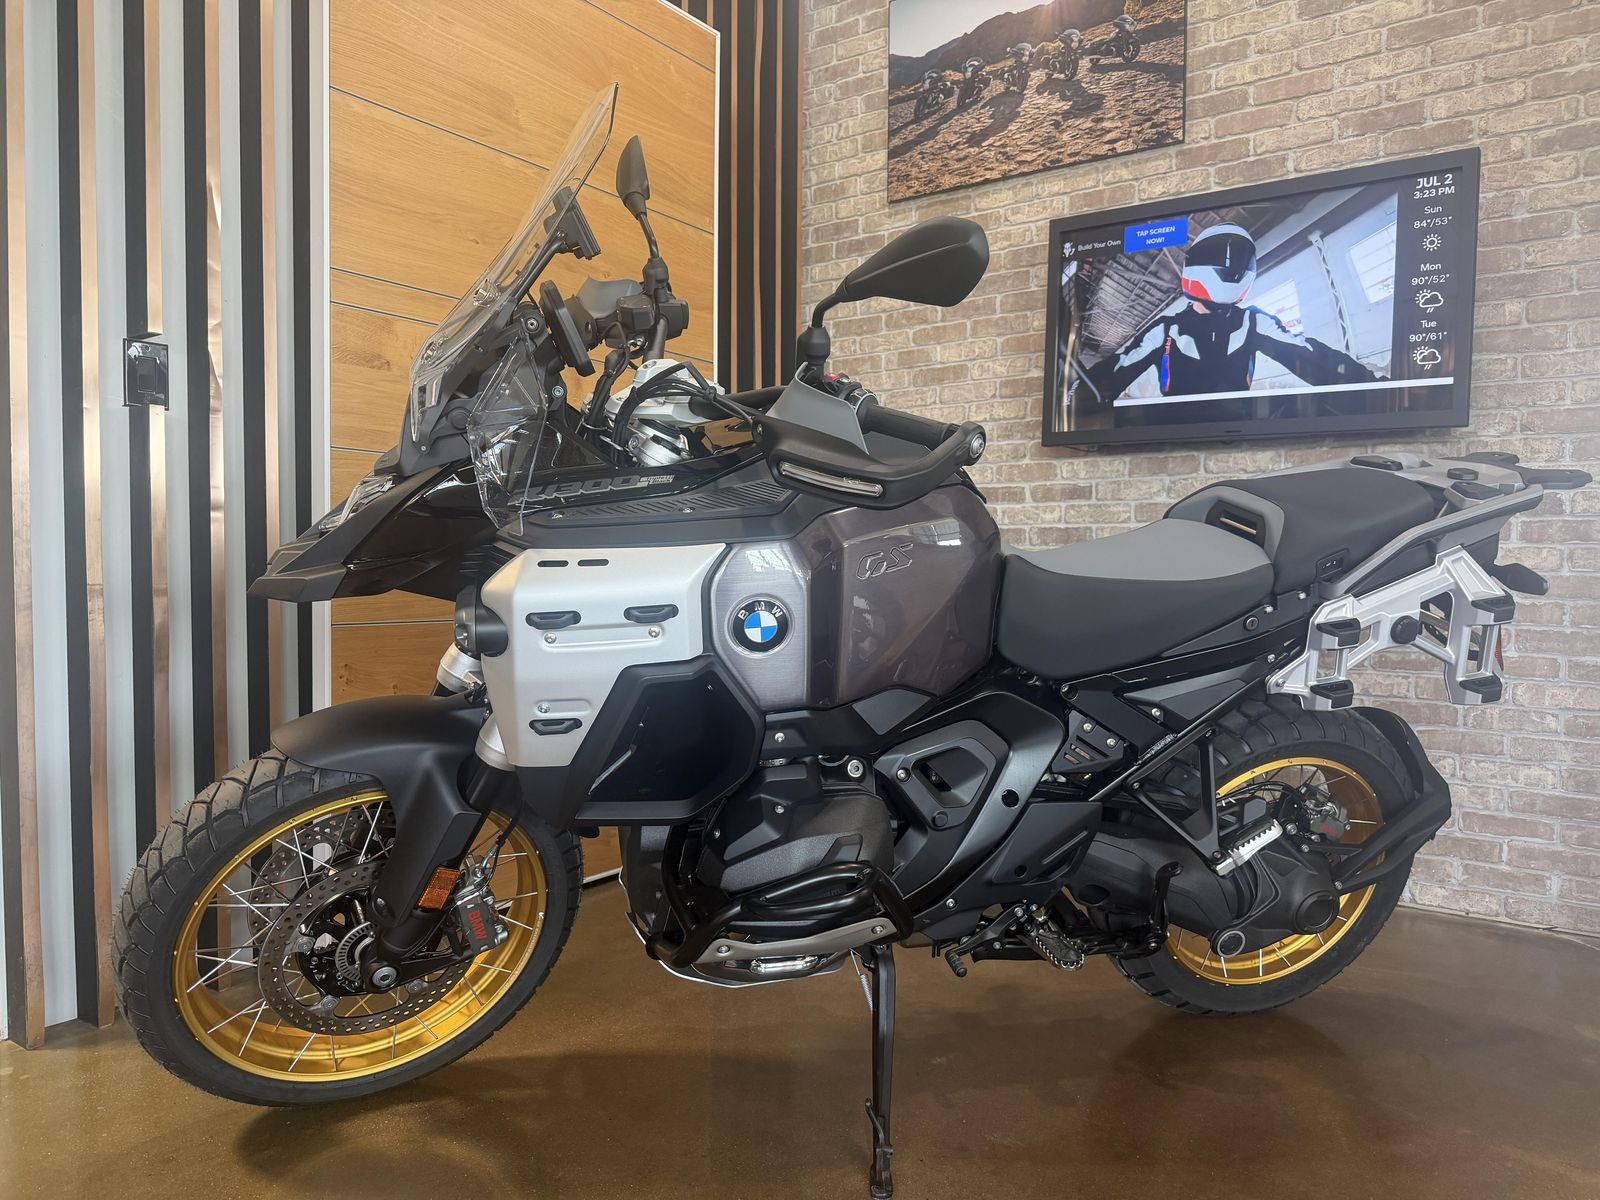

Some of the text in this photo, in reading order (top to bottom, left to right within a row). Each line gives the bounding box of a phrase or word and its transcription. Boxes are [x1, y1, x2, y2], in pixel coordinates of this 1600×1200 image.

[1415, 173, 1453, 189] JUL 2
[1413, 185, 1455, 199] 3:23 PM
[1424, 205, 1443, 214] Sun
[1413, 216, 1452, 229] 84°/53°
[1149, 226, 1176, 235] SCREEN
[1077, 239, 1122, 252] Build Your Own
[1145, 236, 1165, 245] NOW!
[1420, 263, 1442, 272] Mon
[1411, 273, 1450, 286] 90°/52°
[1420, 319, 1437, 328] Tue
[1409, 331, 1448, 342] 90°/61°
[856, 542, 914, 580] GS
[737, 601, 783, 620] BMW
[467, 909, 489, 940] BMW
